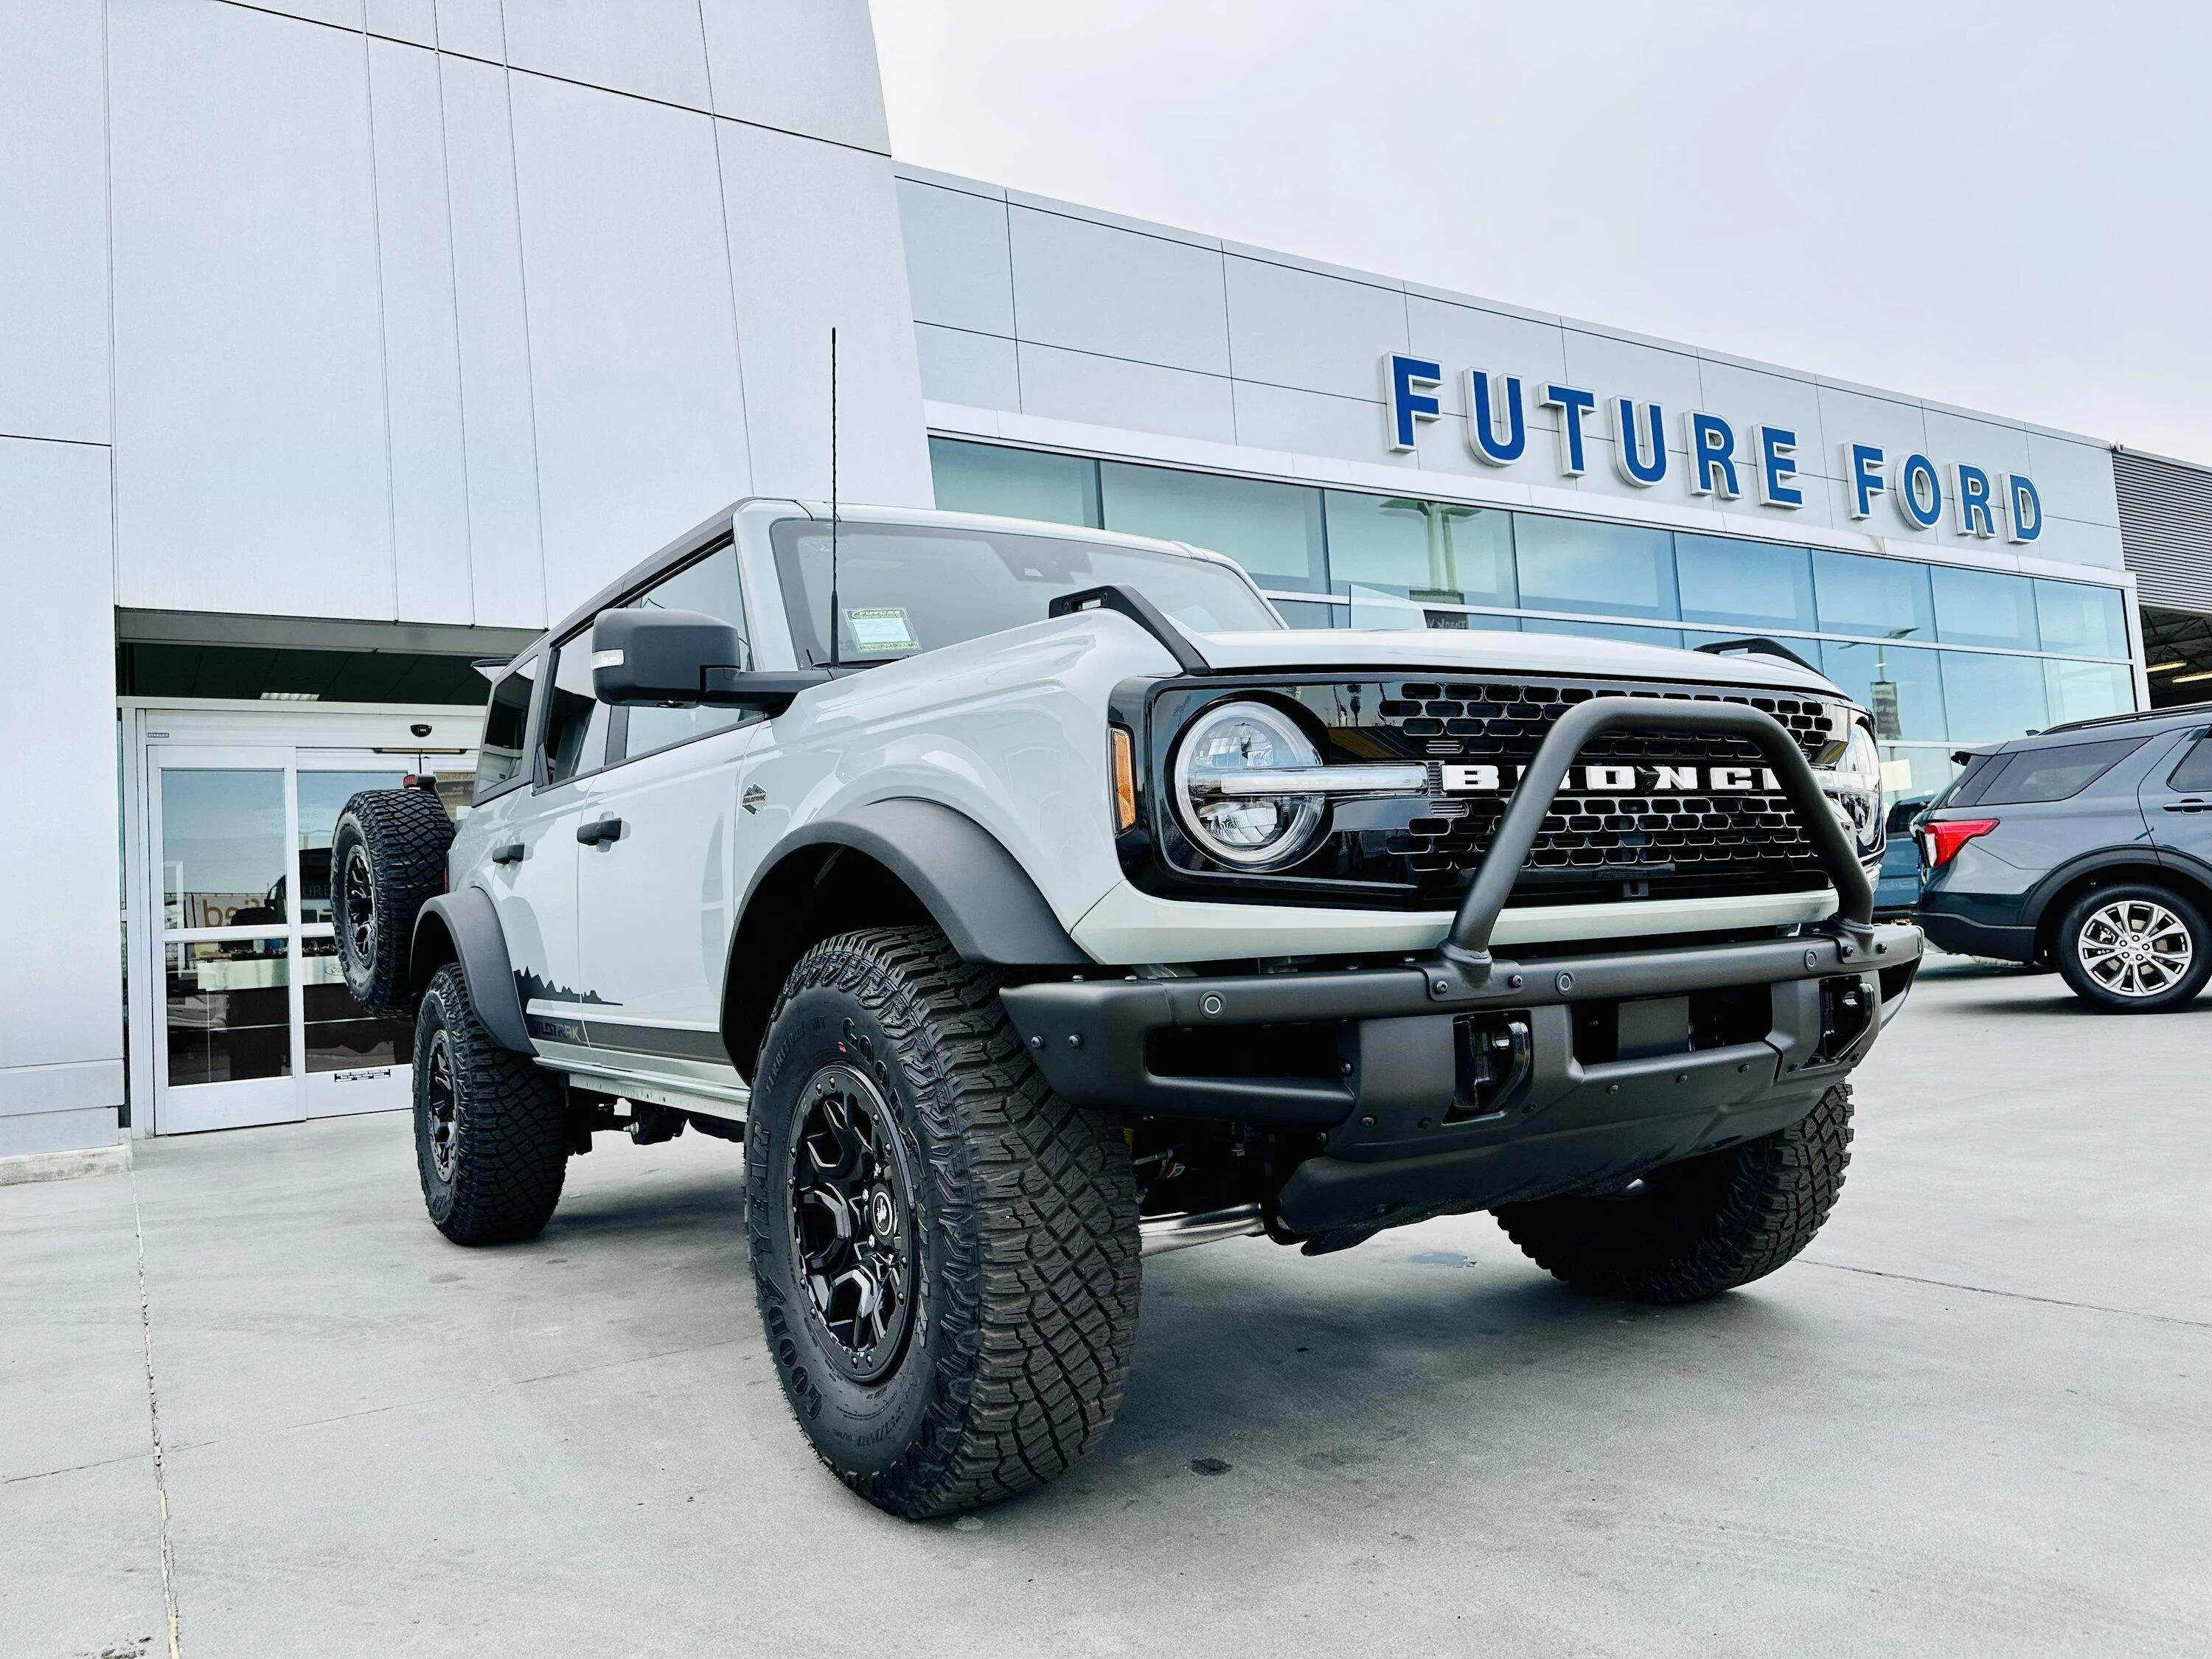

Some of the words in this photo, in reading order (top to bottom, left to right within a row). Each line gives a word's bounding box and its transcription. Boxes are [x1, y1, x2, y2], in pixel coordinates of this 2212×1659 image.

[1381, 351, 1804, 509] FUTURE
[1842, 441, 2044, 544] FORD
[533, 1022, 582, 1043] ILDTRAK
